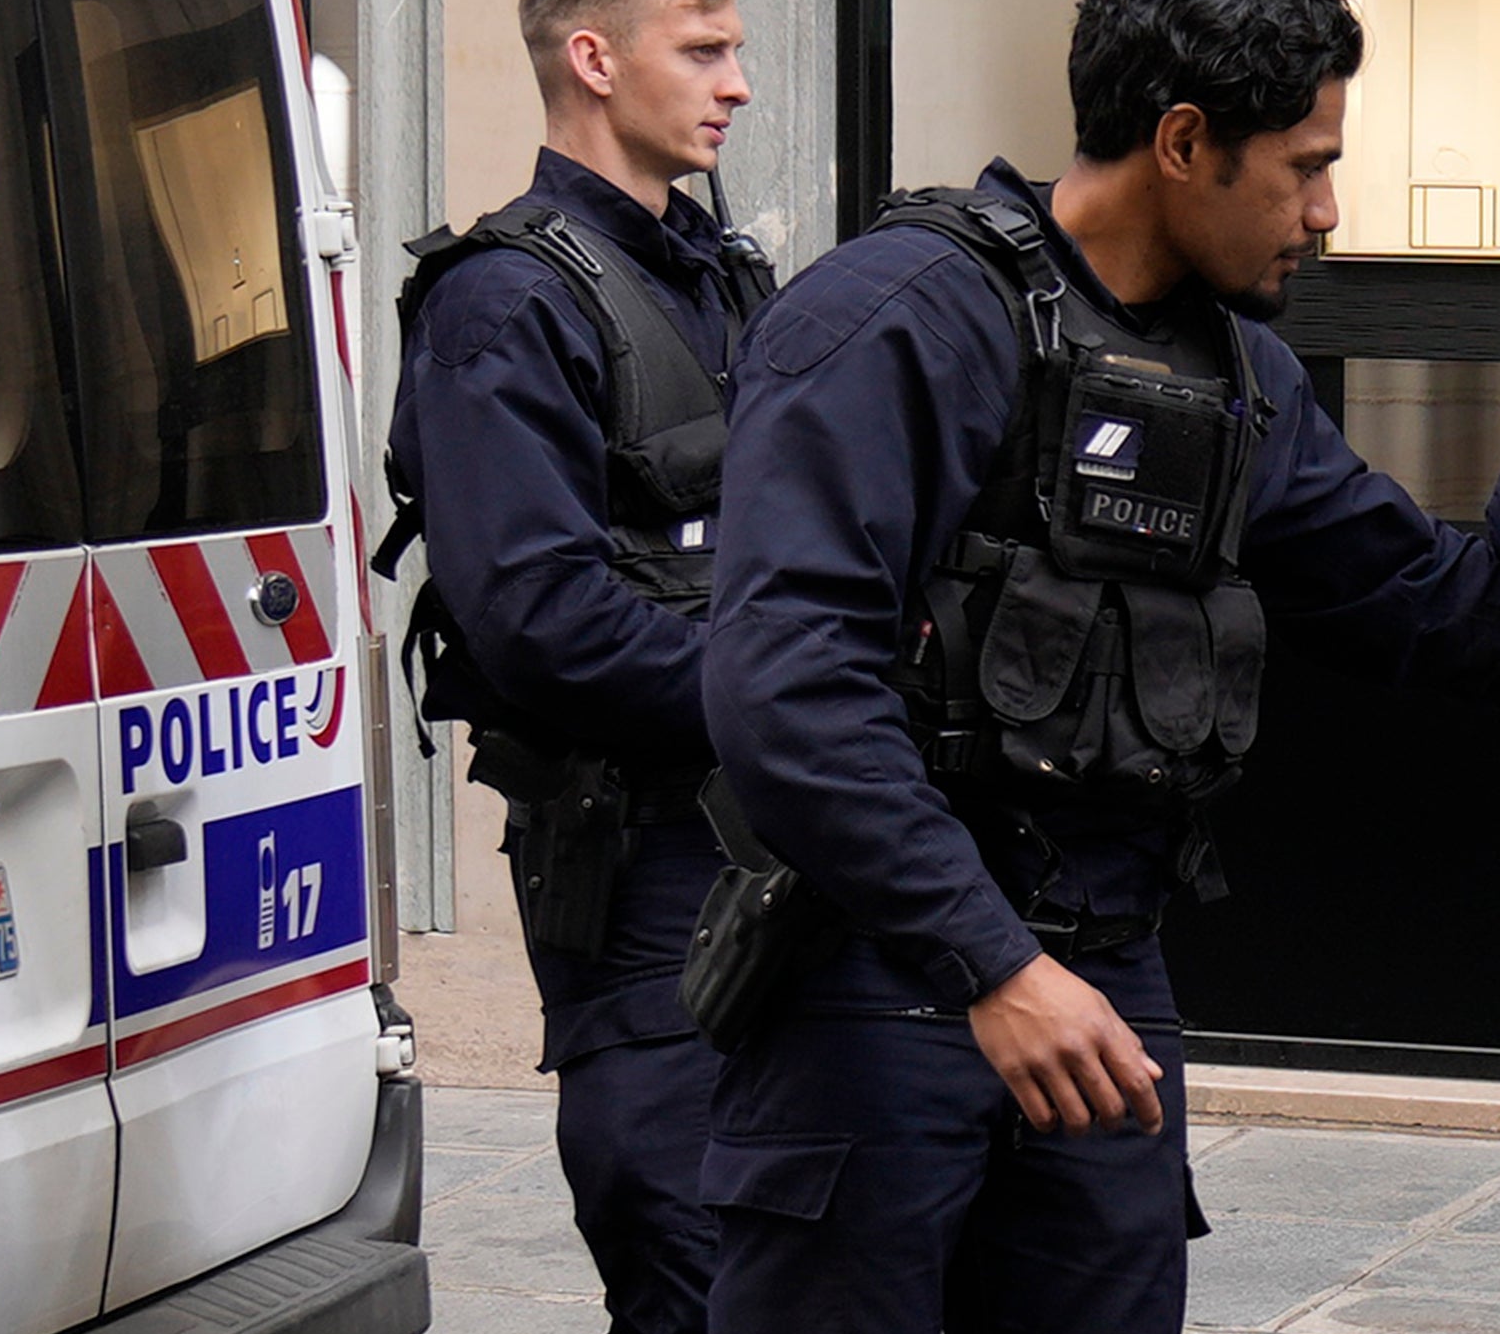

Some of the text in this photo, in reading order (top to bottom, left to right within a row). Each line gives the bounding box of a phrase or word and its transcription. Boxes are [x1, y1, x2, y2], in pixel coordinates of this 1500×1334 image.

[1092, 493, 1195, 538] POLICE
[119, 676, 299, 794] POLICE
[281, 862, 322, 942] 17
